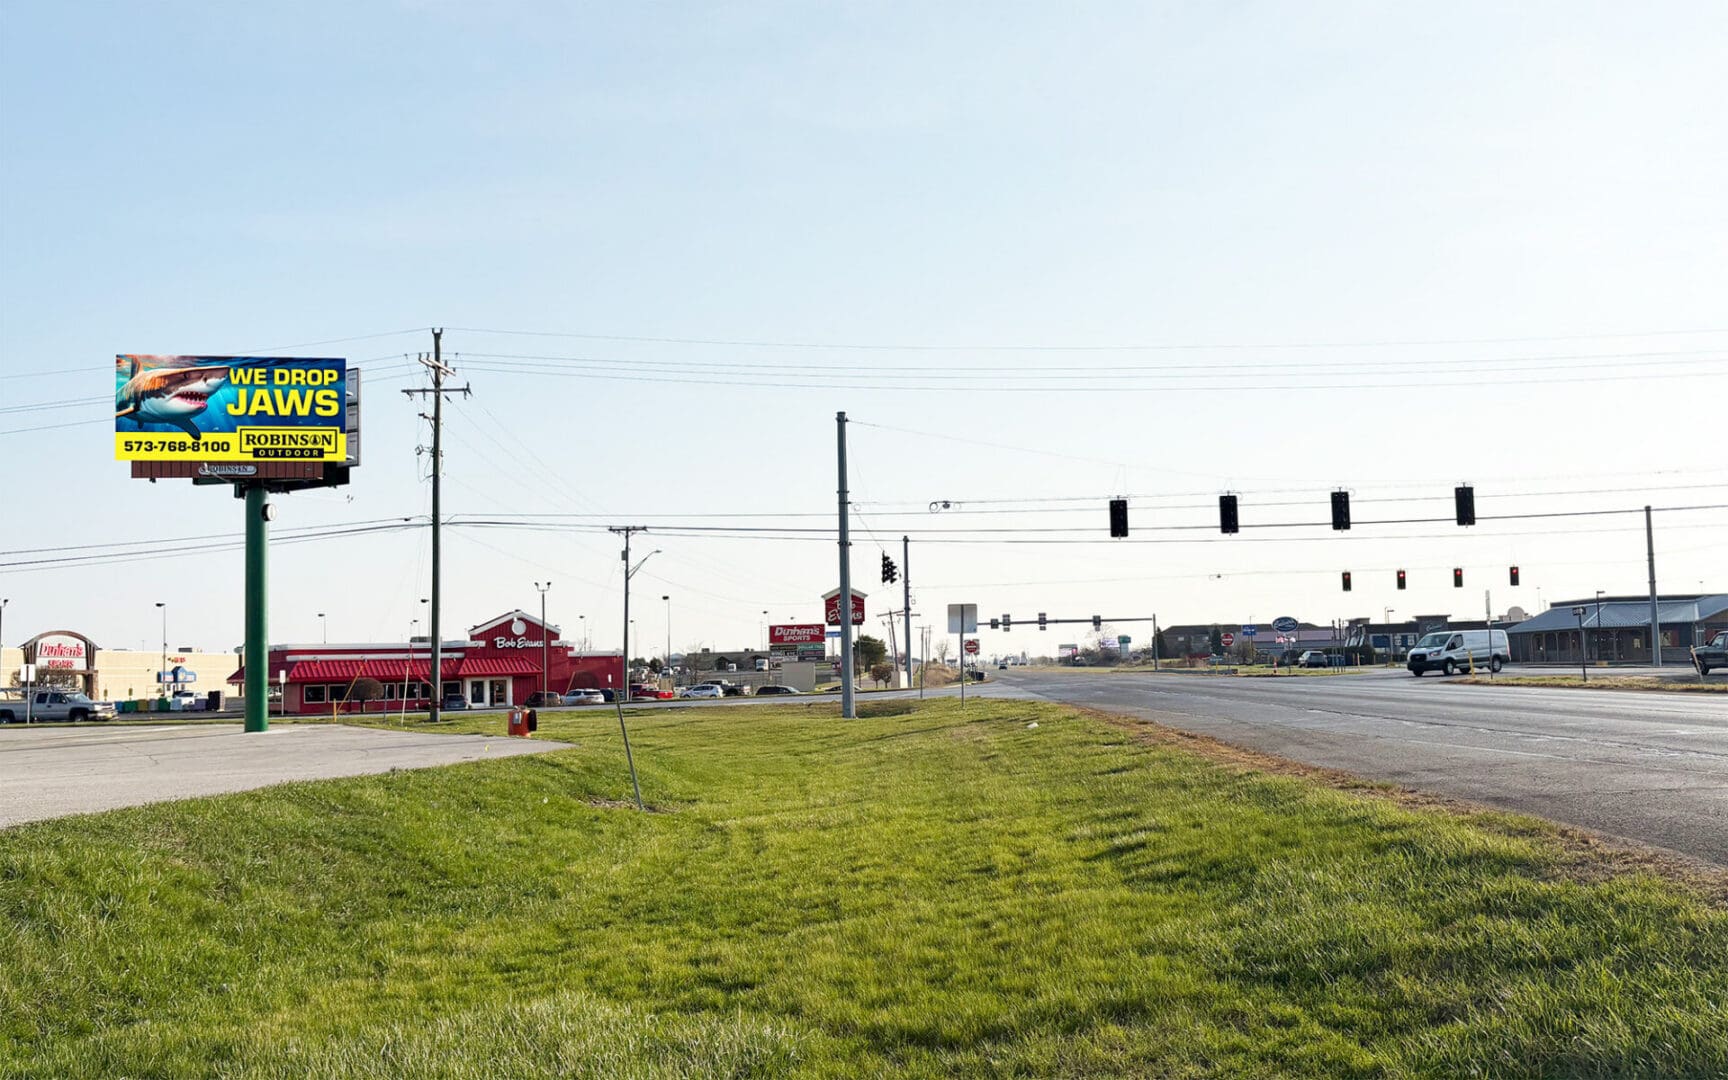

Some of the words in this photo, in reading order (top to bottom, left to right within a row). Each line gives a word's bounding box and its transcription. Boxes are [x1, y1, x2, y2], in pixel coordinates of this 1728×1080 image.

[229, 368, 267, 385] WE
[274, 369, 338, 386] DROP
[226, 389, 340, 416] JAWS
[124, 441, 231, 453] 573-768-8100
[258, 449, 319, 457] OUTDOOR
[775, 626, 820, 636] Dunham's
[494, 637, 516, 648] Bob
[517, 637, 544, 648] Evans
